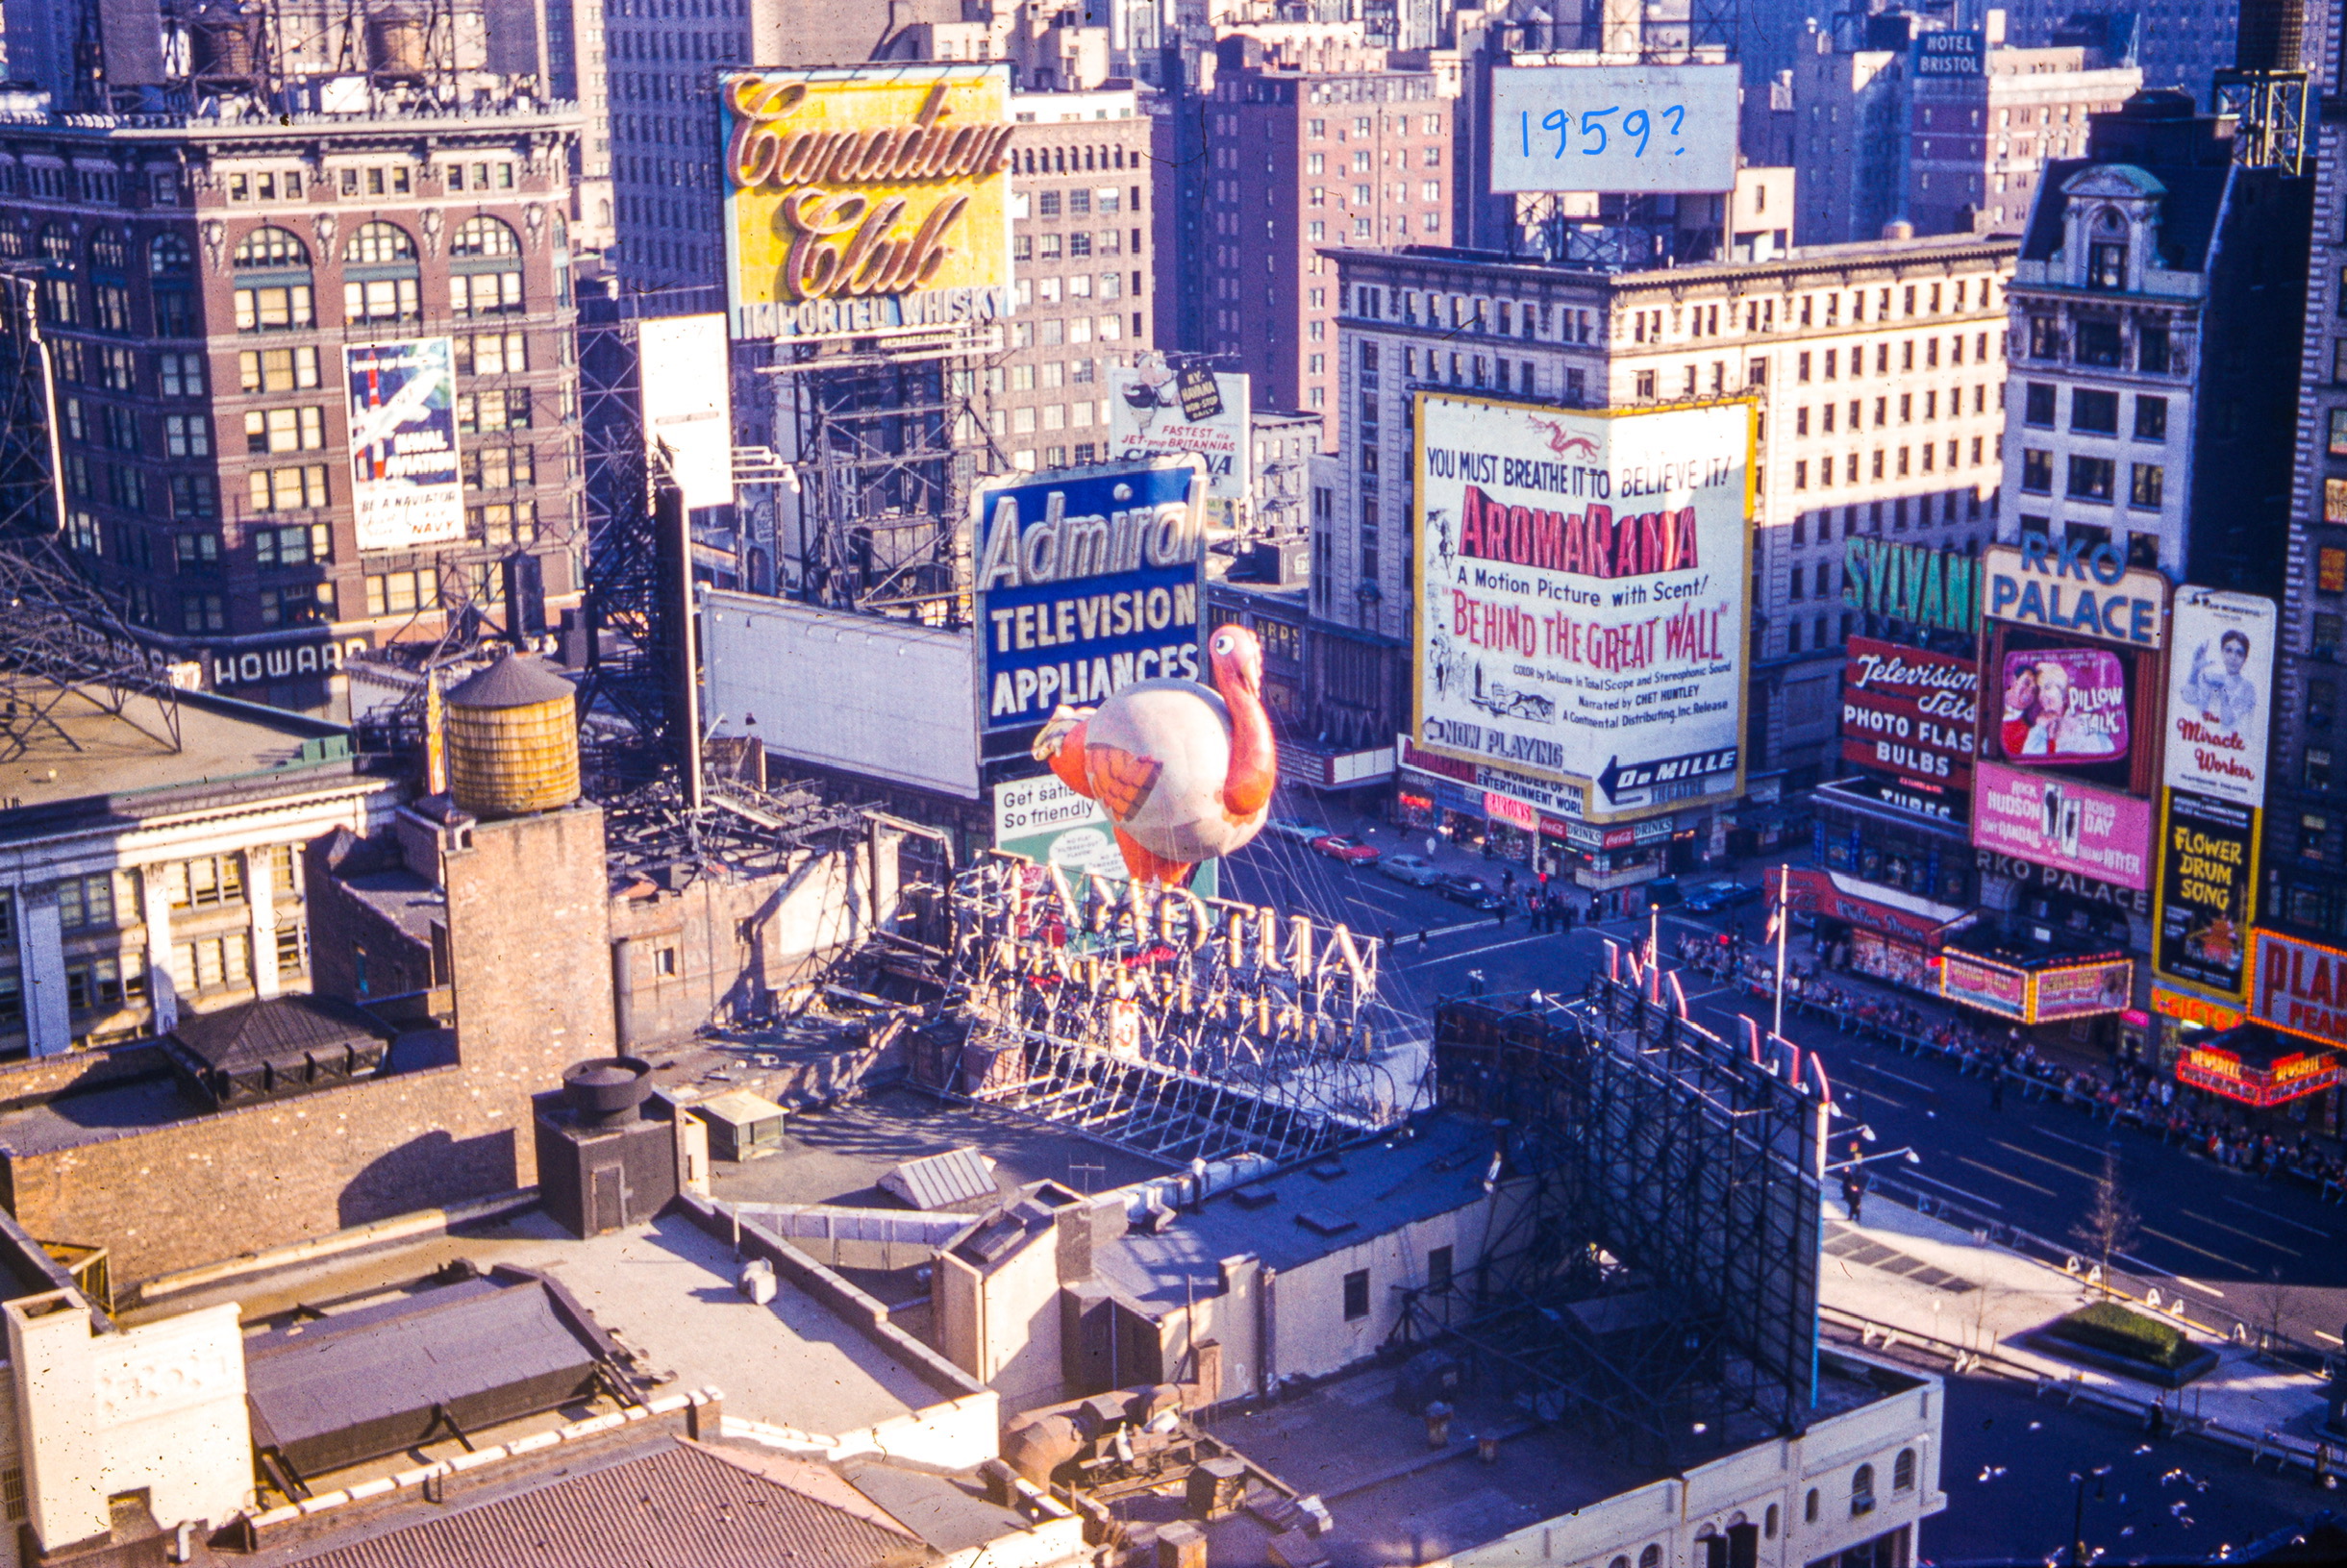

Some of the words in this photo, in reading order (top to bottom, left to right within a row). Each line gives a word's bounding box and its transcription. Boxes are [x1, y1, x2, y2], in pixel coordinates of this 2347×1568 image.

[1927, 35, 1974, 52] HOTEL
[1920, 55, 1979, 73] BRISTOL
[724, 73, 1015, 187] Canadian
[784, 187, 969, 299] Club
[739, 295, 889, 340] IMPORTED
[899, 286, 1008, 325] WHISKY
[1181, 381, 1215, 402] HAVANA
[1192, 407, 1214, 419] DAILY
[393, 429, 449, 455] NAVAL
[1161, 425, 1213, 438] FASTEST
[1215, 430, 1230, 439] via
[1168, 436, 1236, 452] BRITANNIAS
[386, 450, 457, 477] AVIATION
[1427, 446, 1455, 479] YOU
[1460, 449, 1498, 482] MUST
[1504, 457, 1568, 495] BREATHE
[1573, 465, 1585, 496] IT
[1588, 467, 1610, 501] TO
[1621, 459, 1698, 499] BELIEVE
[1705, 456, 1732, 488] IT!
[362, 499, 376, 512] BE
[383, 497, 389, 509] A
[412, 520, 455, 535] NAVY
[976, 475, 1205, 591] Admiral
[1458, 484, 1699, 580] AROMARAMA
[2021, 530, 2126, 586] RKO
[1458, 566, 1468, 585] A
[1474, 566, 1531, 595] Motion
[1537, 577, 1602, 608] Picture
[1611, 583, 1647, 608] with
[1653, 574, 1710, 602] Scent!
[990, 583, 1197, 653] TELEVISION
[1992, 574, 2156, 644] PALACE
[1544, 610, 1582, 664] THE
[1586, 615, 1658, 674] GREAT
[991, 642, 1200, 717] APPLIANCES
[1512, 663, 1536, 679] COLOR
[1536, 668, 1545, 683] by
[1546, 672, 1573, 686] DeLuxe
[1636, 674, 1652, 686] and
[1654, 666, 1707, 684] Stereophonic
[1709, 660, 1732, 675] Sound
[1856, 655, 1978, 691] Television
[1578, 695, 1619, 711] Narrated
[1622, 694, 1633, 709] by
[1635, 690, 1658, 707] CHET
[1660, 684, 1700, 702] HUNTLEY
[1917, 690, 1977, 723] Sets
[1562, 709, 1568, 721] A
[1569, 711, 1619, 729] Continental
[1693, 700, 1729, 714] Release
[1844, 704, 1910, 737] PHOTO
[1442, 719, 1482, 750] NOW
[1486, 728, 1564, 768] PLAYING
[2177, 717, 2245, 751] Miracle
[1656, 750, 1737, 781] MILLE
[1876, 740, 1950, 778] BULBS
[2195, 748, 2255, 781] Worker
[1003, 789, 1033, 809] Get
[1477, 773, 1553, 806] ENTERTAINMENT
[1503, 769, 1549, 788] WONDER
[1552, 780, 1564, 794] OF
[1568, 784, 1585, 800] TH
[1004, 812, 1026, 829] So
[1031, 800, 1095, 825] friendly
[1987, 791, 2040, 819] HUDSON
[1567, 823, 1602, 844] DRINKS
[1635, 817, 1672, 837] DRINKS
[2084, 813, 2113, 837] DAY
[2174, 826, 2242, 865] FLOWER
[1976, 850, 2031, 880] RKO
[2043, 866, 2149, 912] PALACE
[2180, 853, 2232, 886] DRUM
[2181, 879, 2230, 911] SONG
[2167, 996, 2228, 1032] GIFTS
